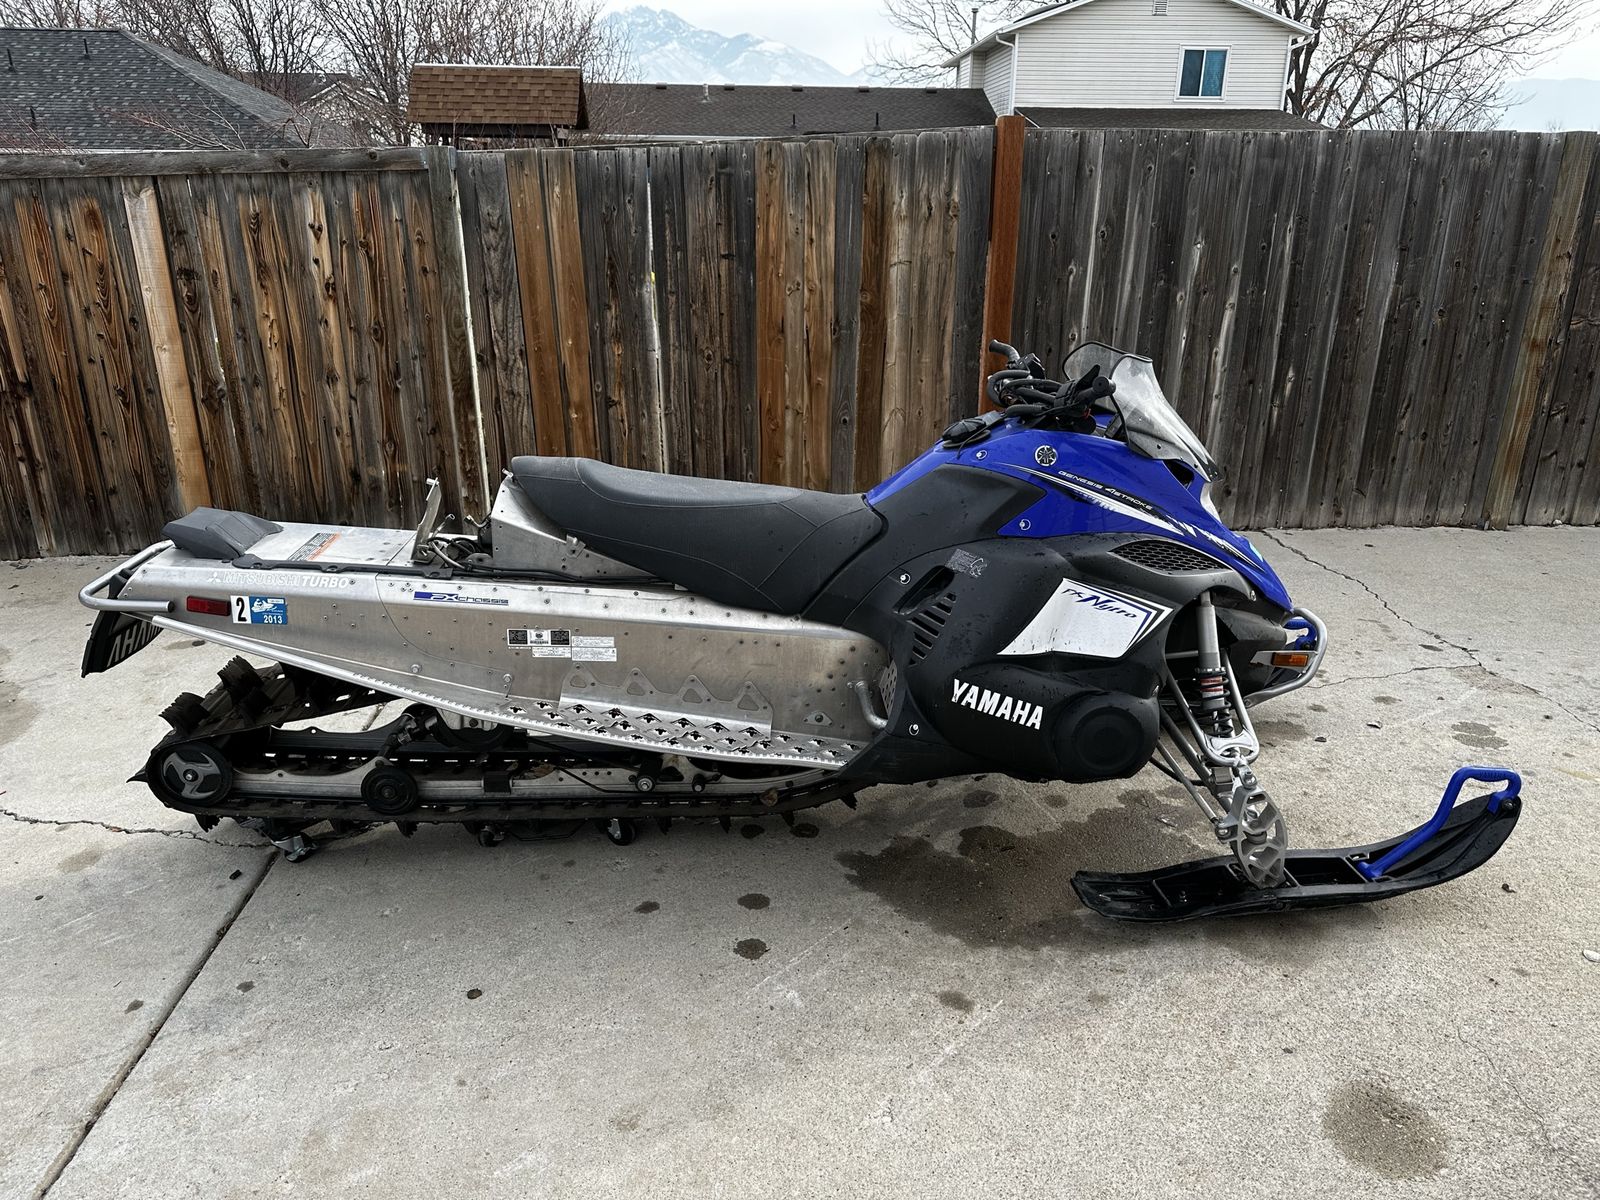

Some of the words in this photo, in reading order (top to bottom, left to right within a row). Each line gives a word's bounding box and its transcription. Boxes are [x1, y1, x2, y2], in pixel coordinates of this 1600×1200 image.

[1058, 470, 1103, 489] GENESIS
[1105, 487, 1153, 510] 4STROKE
[222, 571, 300, 586] MITSUBISHI
[302, 575, 349, 589] TURBO
[236, 597, 247, 622] 2
[263, 614, 283, 624] 2013
[951, 678, 1043, 730] YAMAHA
